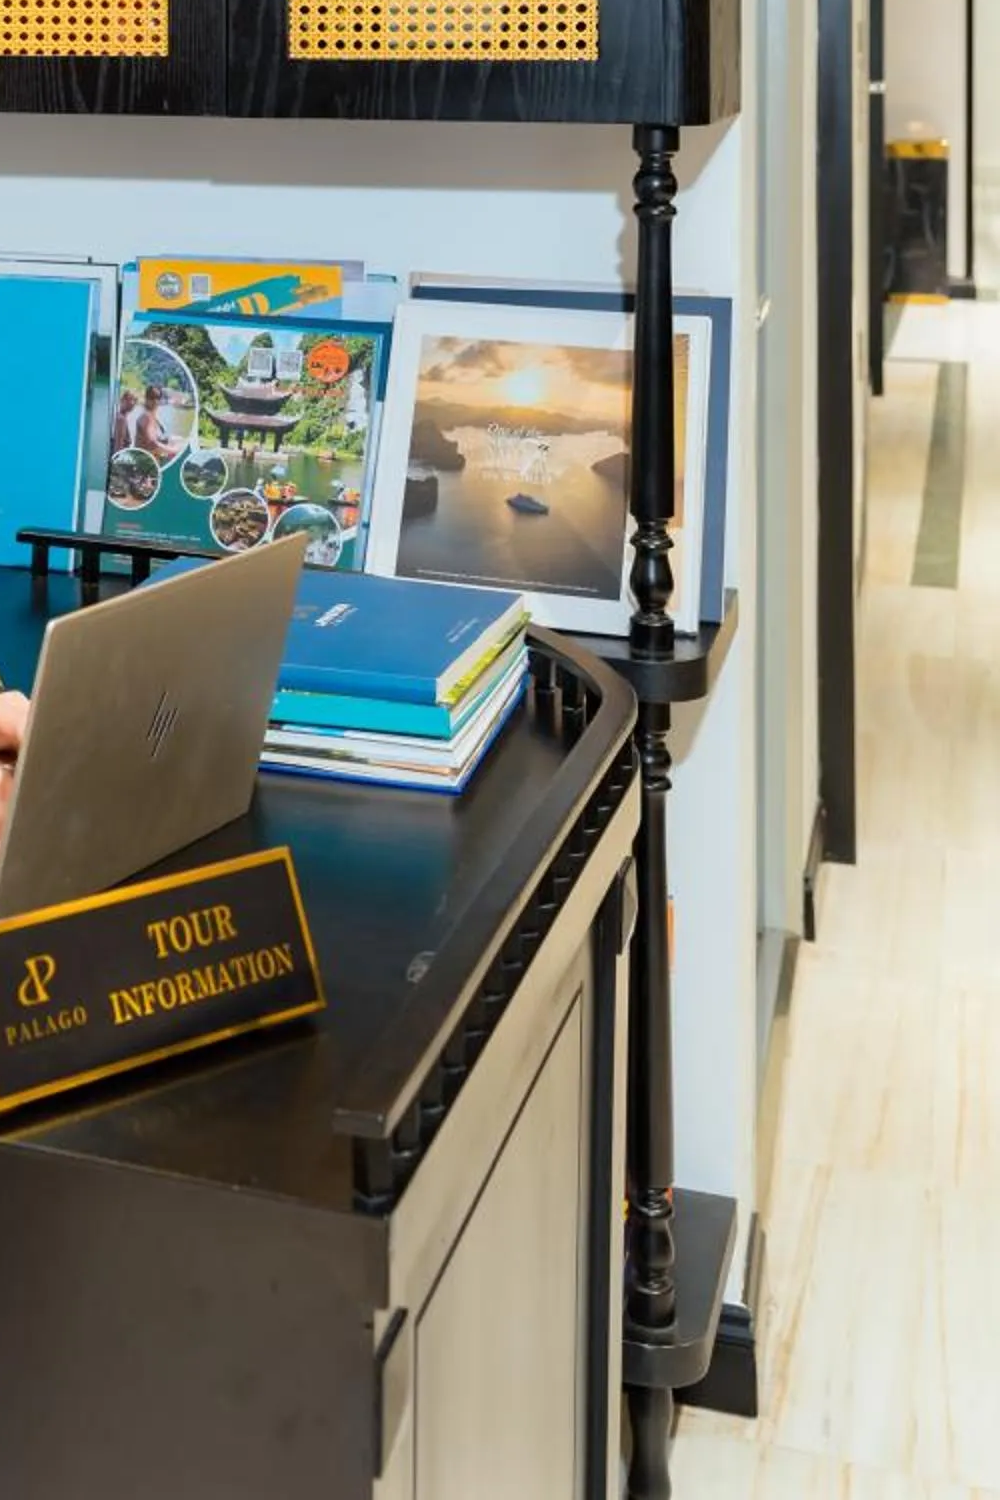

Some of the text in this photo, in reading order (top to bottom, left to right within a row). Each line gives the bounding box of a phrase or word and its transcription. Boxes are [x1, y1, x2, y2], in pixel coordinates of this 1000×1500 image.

[148, 904, 237, 959] TOUR
[108, 943, 295, 1025] INFORMATION
[5, 1005, 88, 1046] PALAGO
